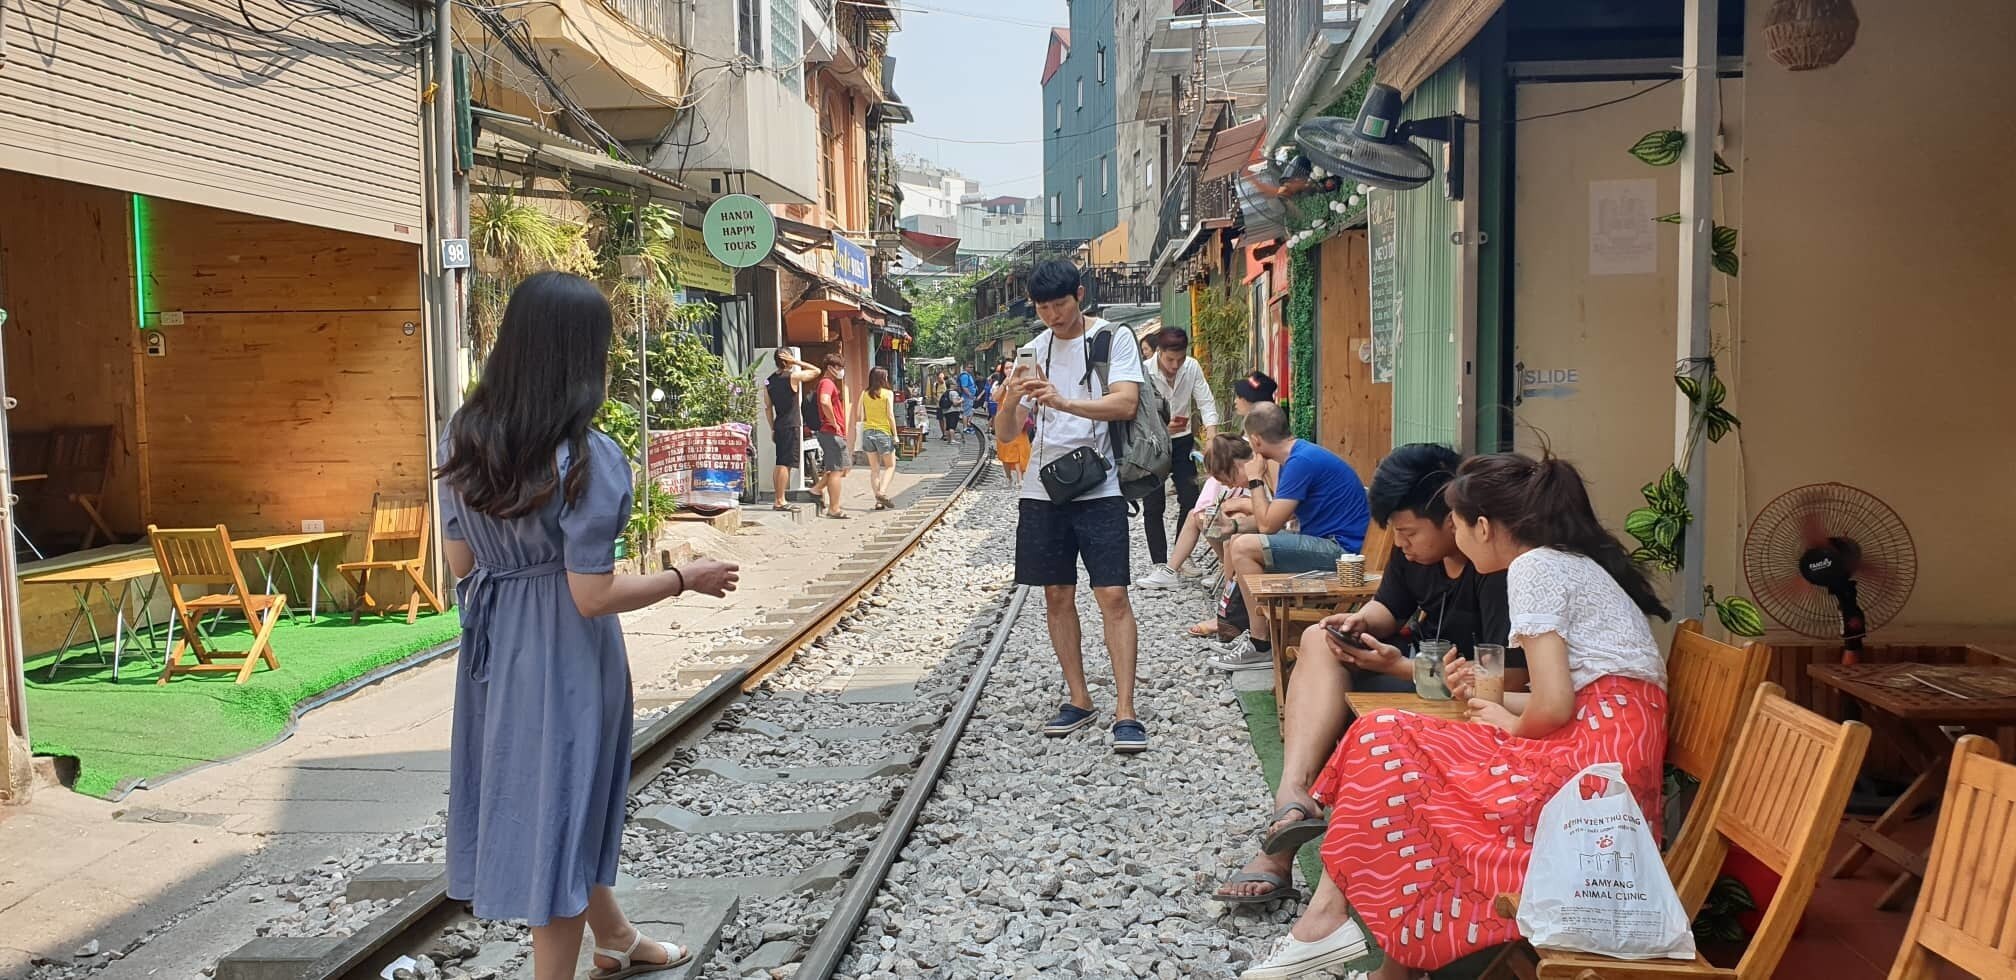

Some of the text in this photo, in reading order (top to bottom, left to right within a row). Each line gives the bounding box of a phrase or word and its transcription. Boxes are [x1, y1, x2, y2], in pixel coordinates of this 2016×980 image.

[722, 225, 755, 236] HAPPY
[724, 240, 757, 251] TOURS
[448, 244, 465, 262] 98
[1523, 368, 1577, 385] SLIDE
[1585, 878, 1634, 889] SAMYANG
[1574, 890, 1648, 901] ANIMAL CLINIC
